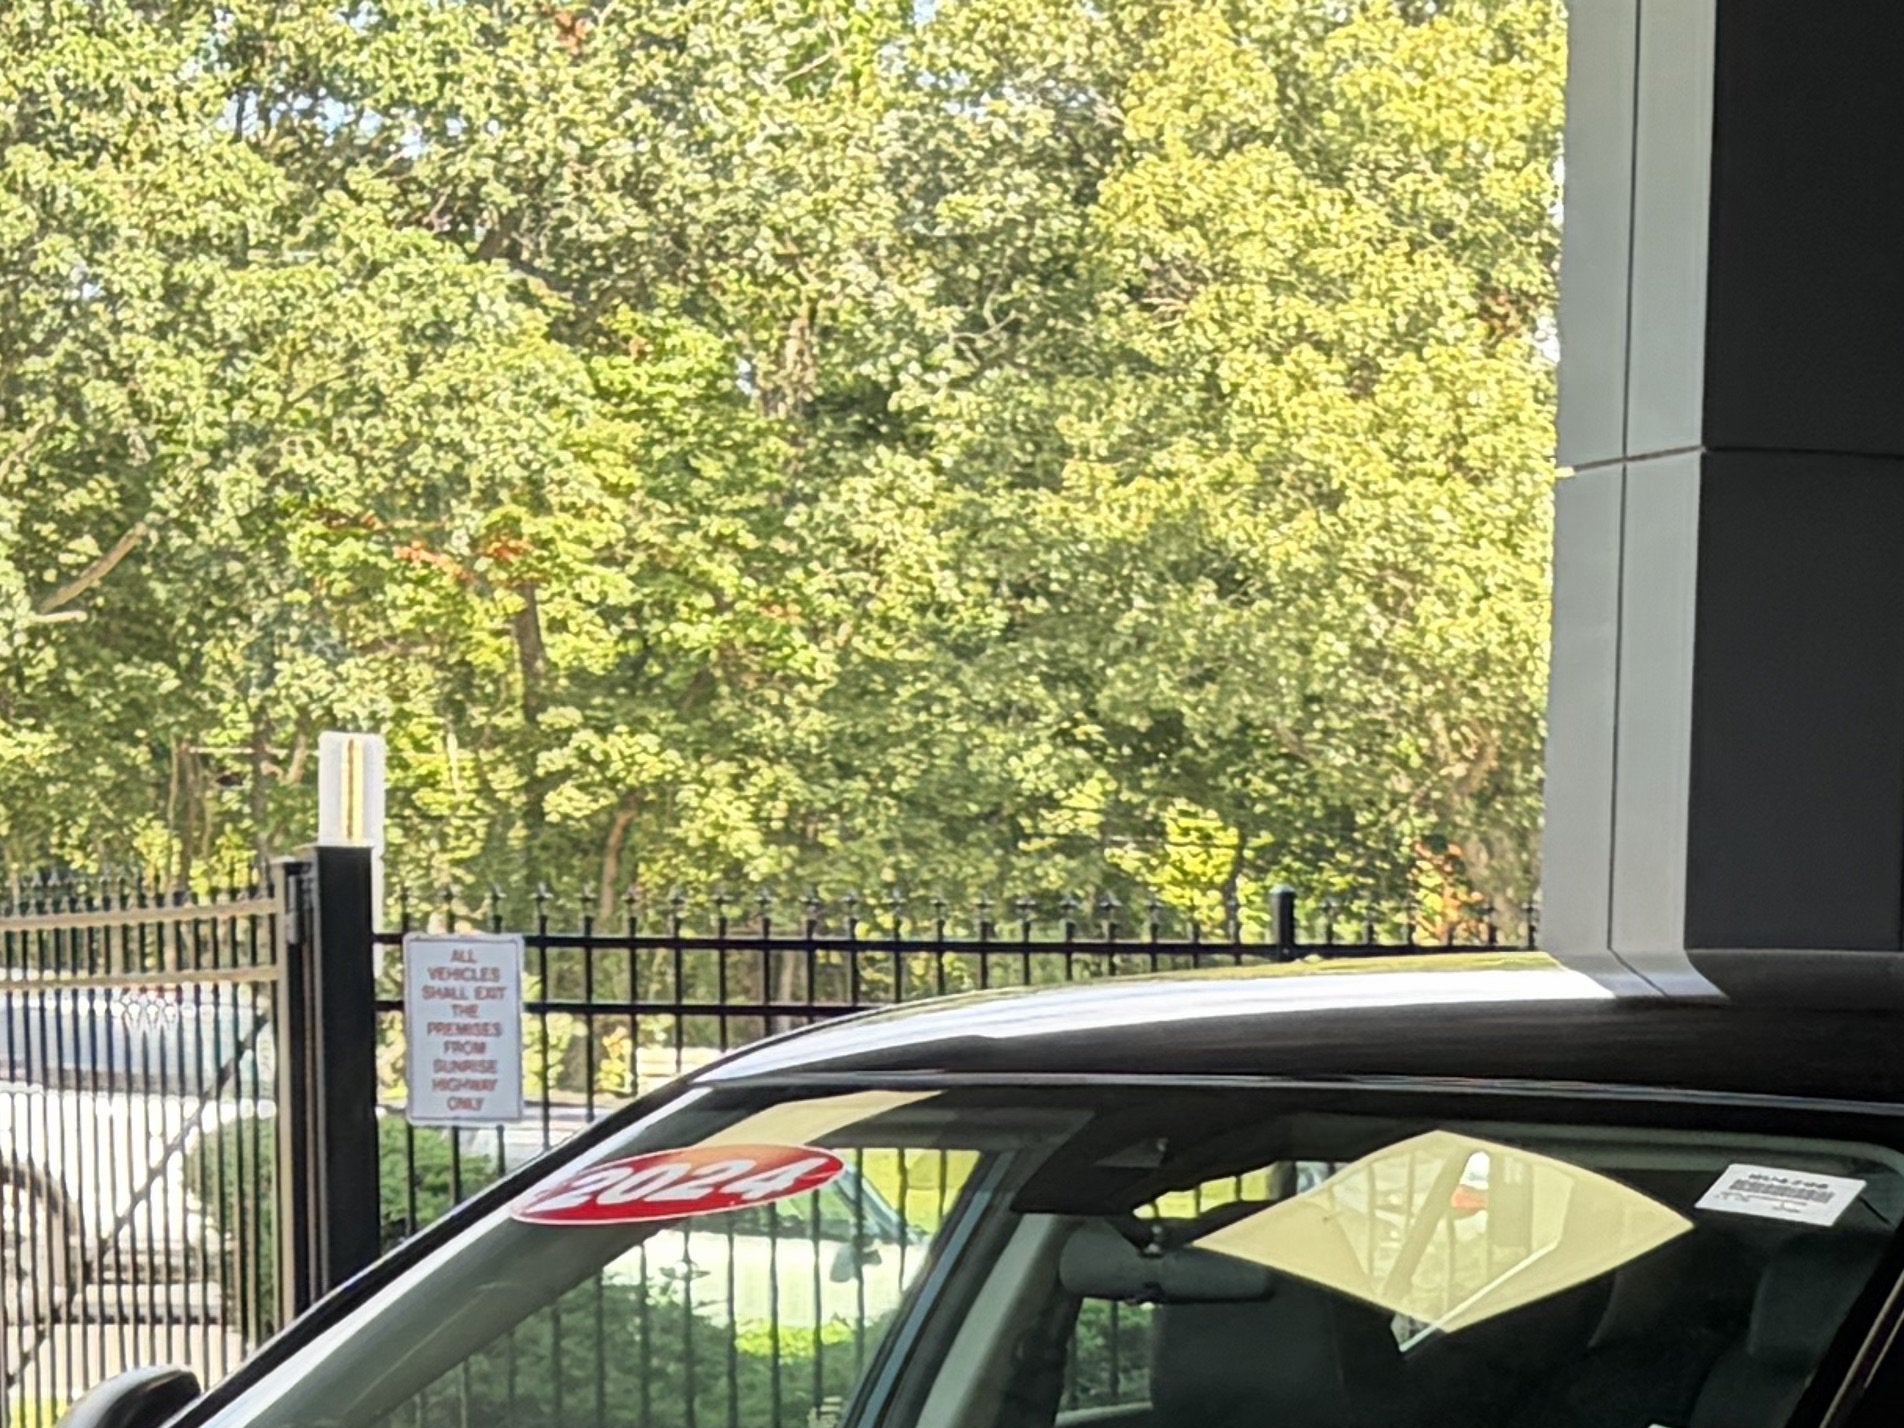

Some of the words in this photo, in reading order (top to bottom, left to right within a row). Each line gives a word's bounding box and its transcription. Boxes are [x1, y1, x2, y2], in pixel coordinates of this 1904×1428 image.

[451, 949, 477, 963] ALL
[428, 967, 500, 982] VEHICLES
[422, 985, 469, 1000] SHALL
[474, 986, 507, 1000] EXIT
[452, 1003, 479, 1018] THE
[427, 1022, 502, 1038] PREMISES
[444, 1040, 487, 1055] FROM
[433, 1059, 498, 1073] SUNRISE
[432, 1078, 498, 1092] HIGHWAY
[447, 1096, 484, 1111] ONLY
[523, 1157, 829, 1213] 2024
